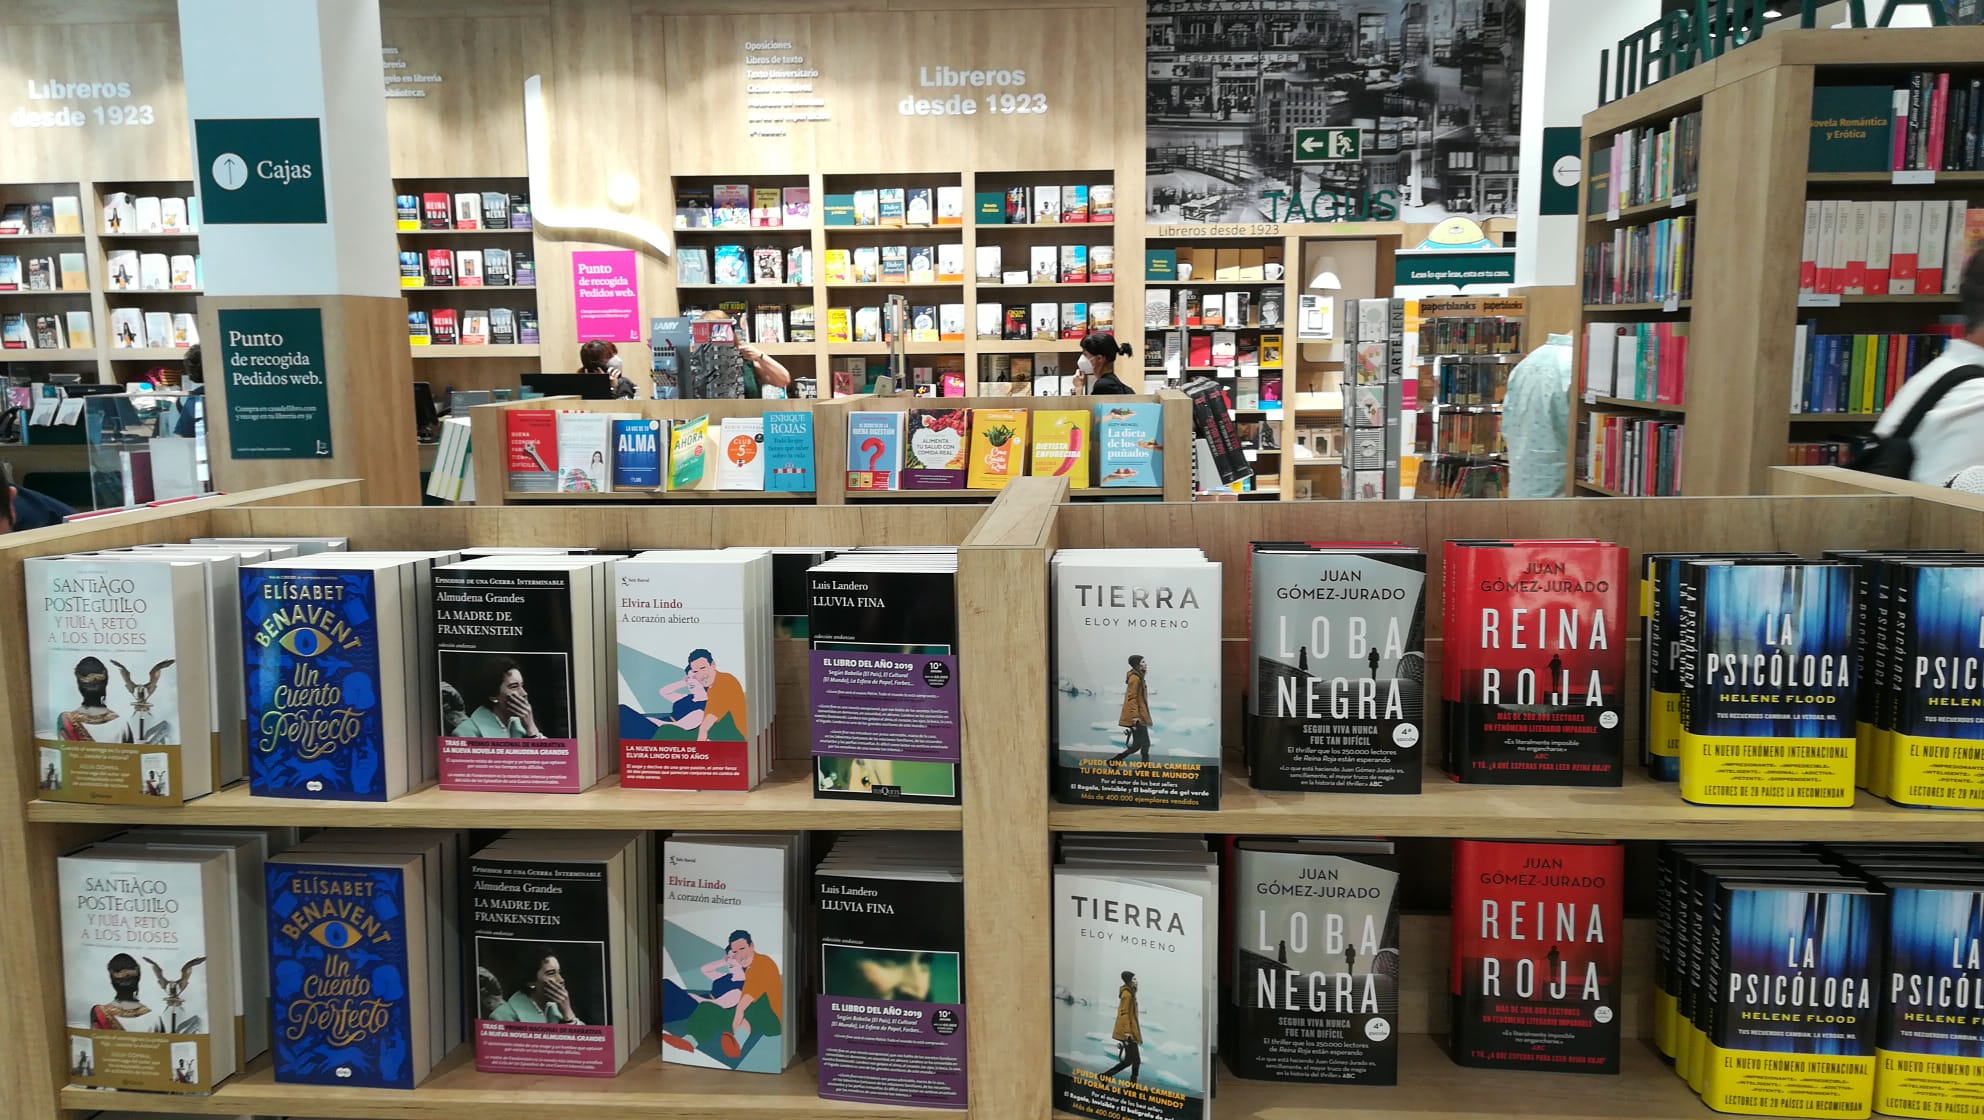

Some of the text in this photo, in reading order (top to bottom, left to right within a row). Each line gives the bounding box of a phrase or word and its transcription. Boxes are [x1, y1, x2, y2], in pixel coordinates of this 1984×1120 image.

[745, 40, 792, 52] Oposiciones
[746, 56, 804, 65] Libros de texto
[769, 68, 819, 78] Universitario
[920, 66, 1026, 87] Libreros
[28, 79, 132, 100] Libreros
[898, 93, 1048, 116] desde 1923
[10, 104, 156, 128] desde 1923
[1839, 116, 1888, 127] Romántica
[1826, 130, 1867, 141] y Erótica
[256, 160, 313, 185] Cajas
[1263, 190, 1397, 224] TAGUS
[1158, 224, 1280, 237] Libreros desde 1923
[577, 263, 613, 274] Punto
[578, 275, 629, 288] de recogida
[579, 288, 636, 298] Pedidos web.
[1421, 301, 1523, 314] paperblanks paperblanks
[653, 321, 680, 330] LAMY
[229, 330, 284, 347] Punto
[231, 352, 311, 370] de recogida
[232, 371, 323, 386] Pedidos web.
[770, 414, 806, 423] ENRIQUE
[770, 423, 807, 434] ROJAS
[1107, 428, 1146, 438] La dieta
[618, 434, 656, 452] ALMA
[675, 431, 704, 450] AHORA
[1107, 439, 1136, 448] de los
[736, 445, 746, 457] 5
[1035, 450, 1081, 458] ENFURECIDA
[1320, 570, 1361, 582] JUAN
[1524, 562, 1565, 575] JUAN
[53, 576, 135, 596] SANTIAGO
[264, 582, 344, 601] ELÍSABET
[812, 580, 869, 591] Luis Landero
[1277, 584, 1406, 600] GÓMEZ-JURADO
[1480, 577, 1610, 593] GÓMEZ-JURADO
[45, 596, 147, 613] POSTEGUILLO
[437, 592, 525, 604] Almudena Grandes
[621, 598, 683, 609] Elvira Lindo
[813, 596, 886, 608] LLUVIA FINA
[1075, 584, 1200, 610] TIERRA
[55, 614, 138, 631] Y JULIA RETÓ
[437, 610, 513, 622] LA MADRE DE
[622, 613, 700, 624] A corazón abierto
[1085, 617, 1189, 629] ELOY MORENO
[255, 604, 363, 650] BENAVENT
[438, 624, 524, 636] FRANKENSTEIN
[1481, 608, 1608, 650] REINA
[1766, 613, 1793, 646] LA
[48, 631, 147, 645] A LOS DIOSES
[1279, 615, 1404, 660] LOBA
[823, 658, 914, 671] EL LIBRO DEL AÑO 2019
[1706, 648, 1849, 688] PSICÓLOGA
[294, 663, 320, 688] Un
[1482, 668, 1604, 706] ROJA
[275, 685, 341, 711] Cuento
[1277, 676, 1404, 720] NEGRA
[1720, 694, 1836, 704] HELENE FLOOD
[259, 707, 366, 760] Perfecto
[1302, 725, 1378, 735] SEGUIR VIVA NUNCA
[1310, 735, 1371, 746] FUE TAN DIFÍCIL
[1703, 742, 1849, 759] EL NUEVO FENÓMENO INTERNACIONAL
[1523, 858, 1563, 870] JUAN
[668, 876, 727, 890] Elvira Lindo
[1299, 868, 1339, 881] JUAN
[1480, 871, 1606, 889] GÓMEZ-JURADO
[85, 877, 167, 896] SANTIAGO
[292, 876, 374, 897] ELÍSABET
[1256, 880, 1381, 899] GÓMEZ-JURADO
[78, 895, 179, 913] POSTEGUILLO
[821, 900, 895, 914] LLUVIA FINA
[281, 898, 391, 945] BENAVENT
[475, 911, 561, 925] FRANKENSTEIN
[1071, 895, 1185, 936] TIERRA
[1481, 899, 1604, 943] REINA
[1080, 928, 1176, 953] ELOY MORENO
[1259, 910, 1378, 956] LOBA
[1788, 936, 1815, 969] LA
[325, 954, 350, 977] Un
[303, 975, 370, 1000] Cuento
[1482, 957, 1600, 1001] ROJA
[1257, 968, 1379, 1014] NEGRA
[1729, 971, 1870, 1009] PSICÓLOGA
[286, 998, 394, 1047] Perfecto
[1742, 1011, 1856, 1024] HELENE FLOOD
